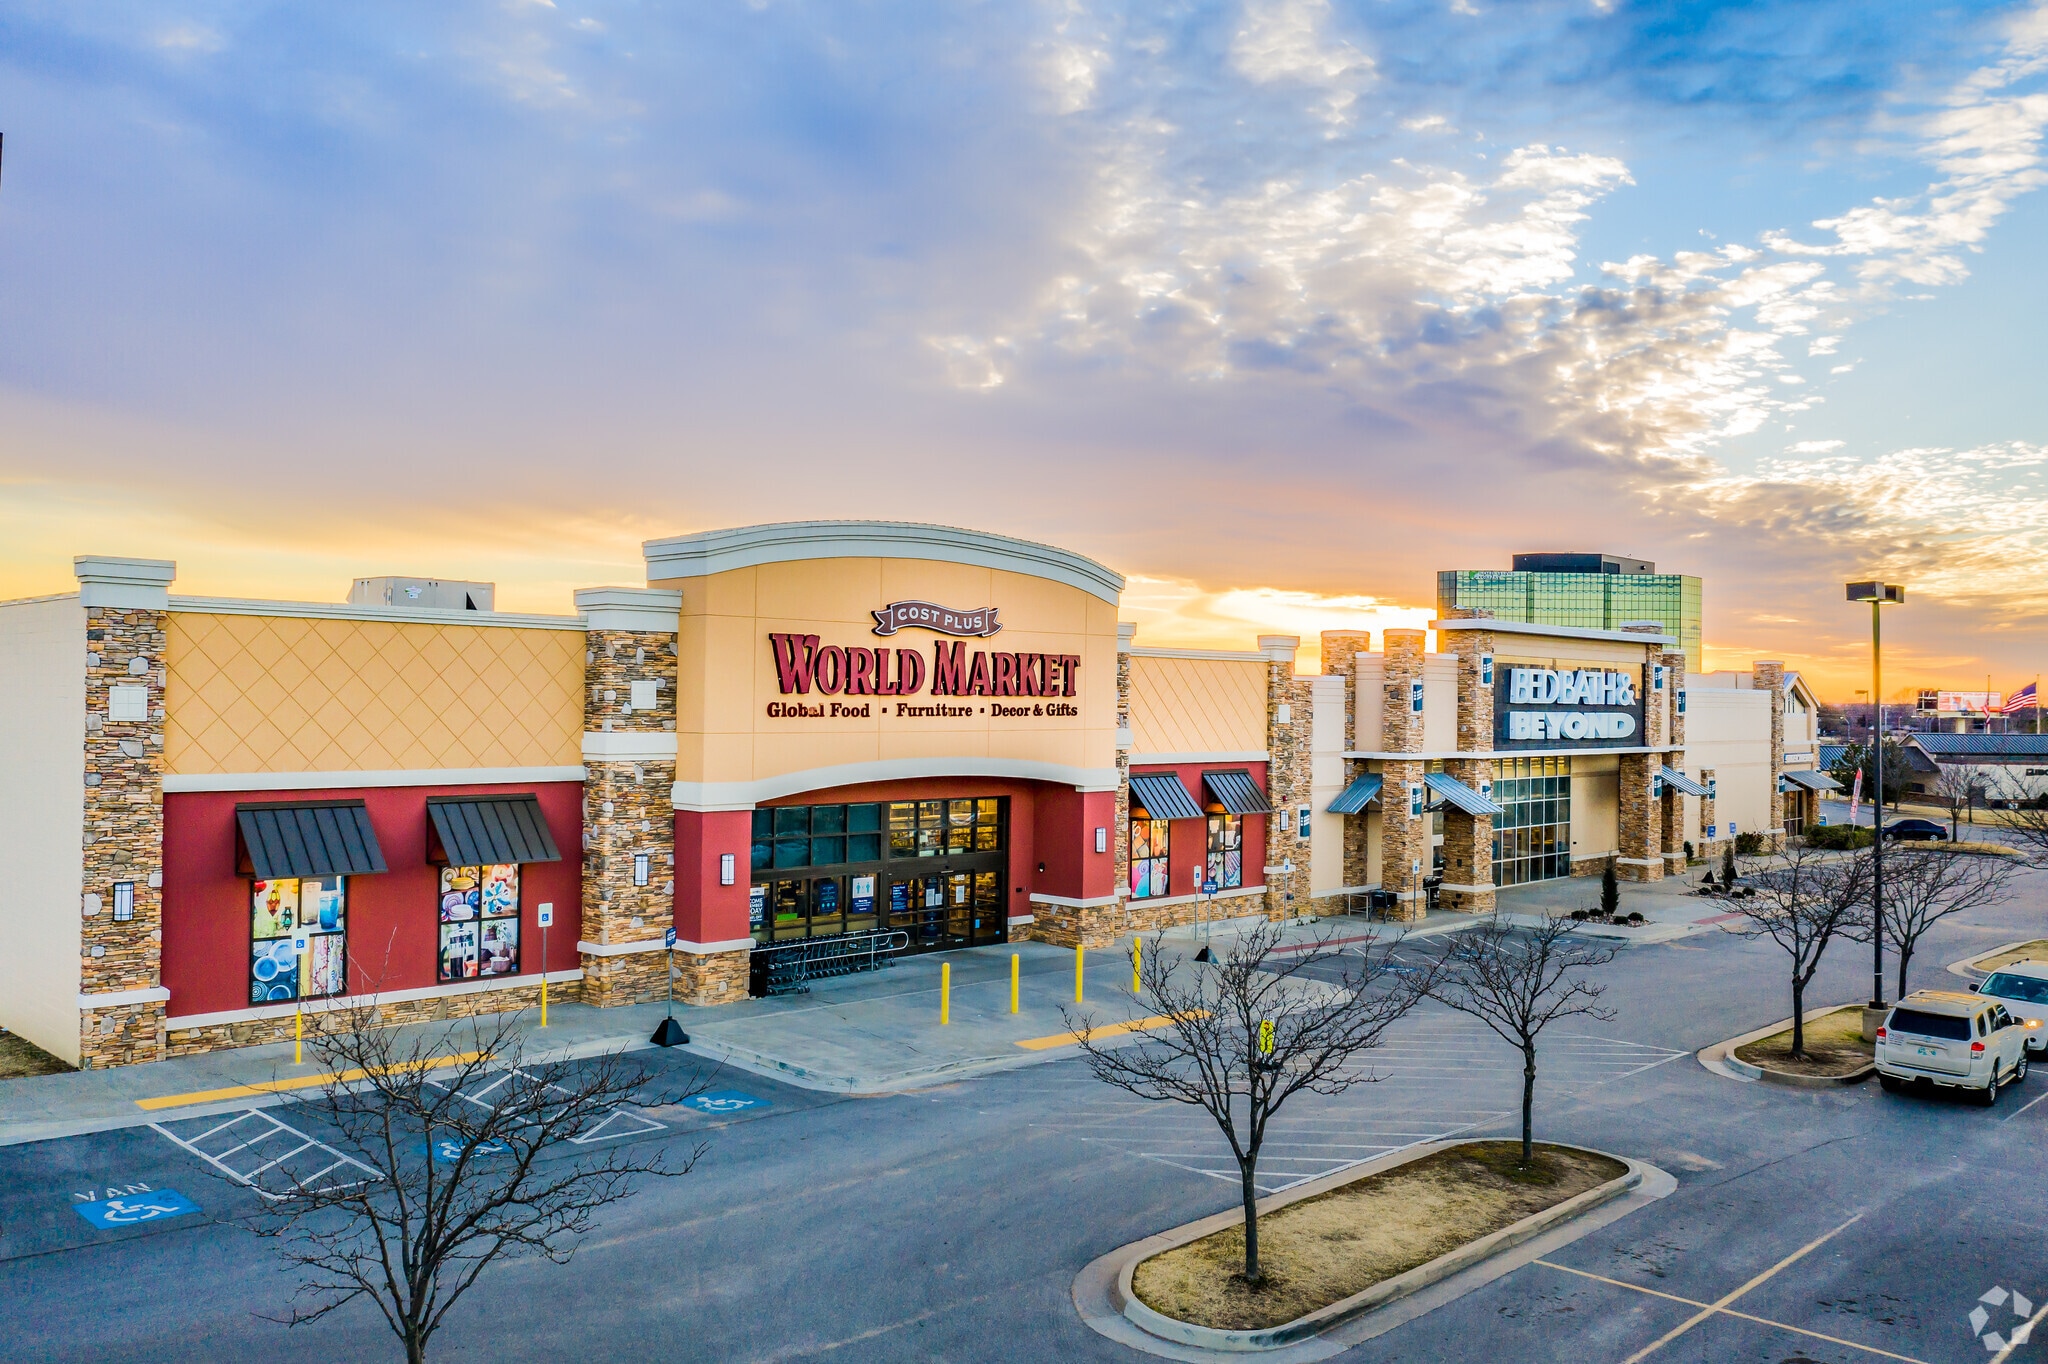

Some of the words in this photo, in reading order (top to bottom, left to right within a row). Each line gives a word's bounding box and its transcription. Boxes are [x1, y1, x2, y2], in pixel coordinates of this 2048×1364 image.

[898, 606, 940, 623] COST
[944, 613, 983, 630] PLUS
[769, 633, 926, 695] WORLD
[931, 640, 1081, 697] MARKET
[1509, 668, 1560, 704] BED
[1557, 670, 1617, 705] BATH
[1616, 672, 1637, 706] &
[767, 702, 825, 717] Global
[830, 702, 870, 717] Food
[896, 702, 973, 717] Furniture
[991, 703, 1031, 717] Decor
[1033, 704, 1044, 717] &
[1046, 703, 1078, 717] Gifts
[1509, 711, 1636, 740] BEYOND
[75, 1182, 154, 1202] VAN
